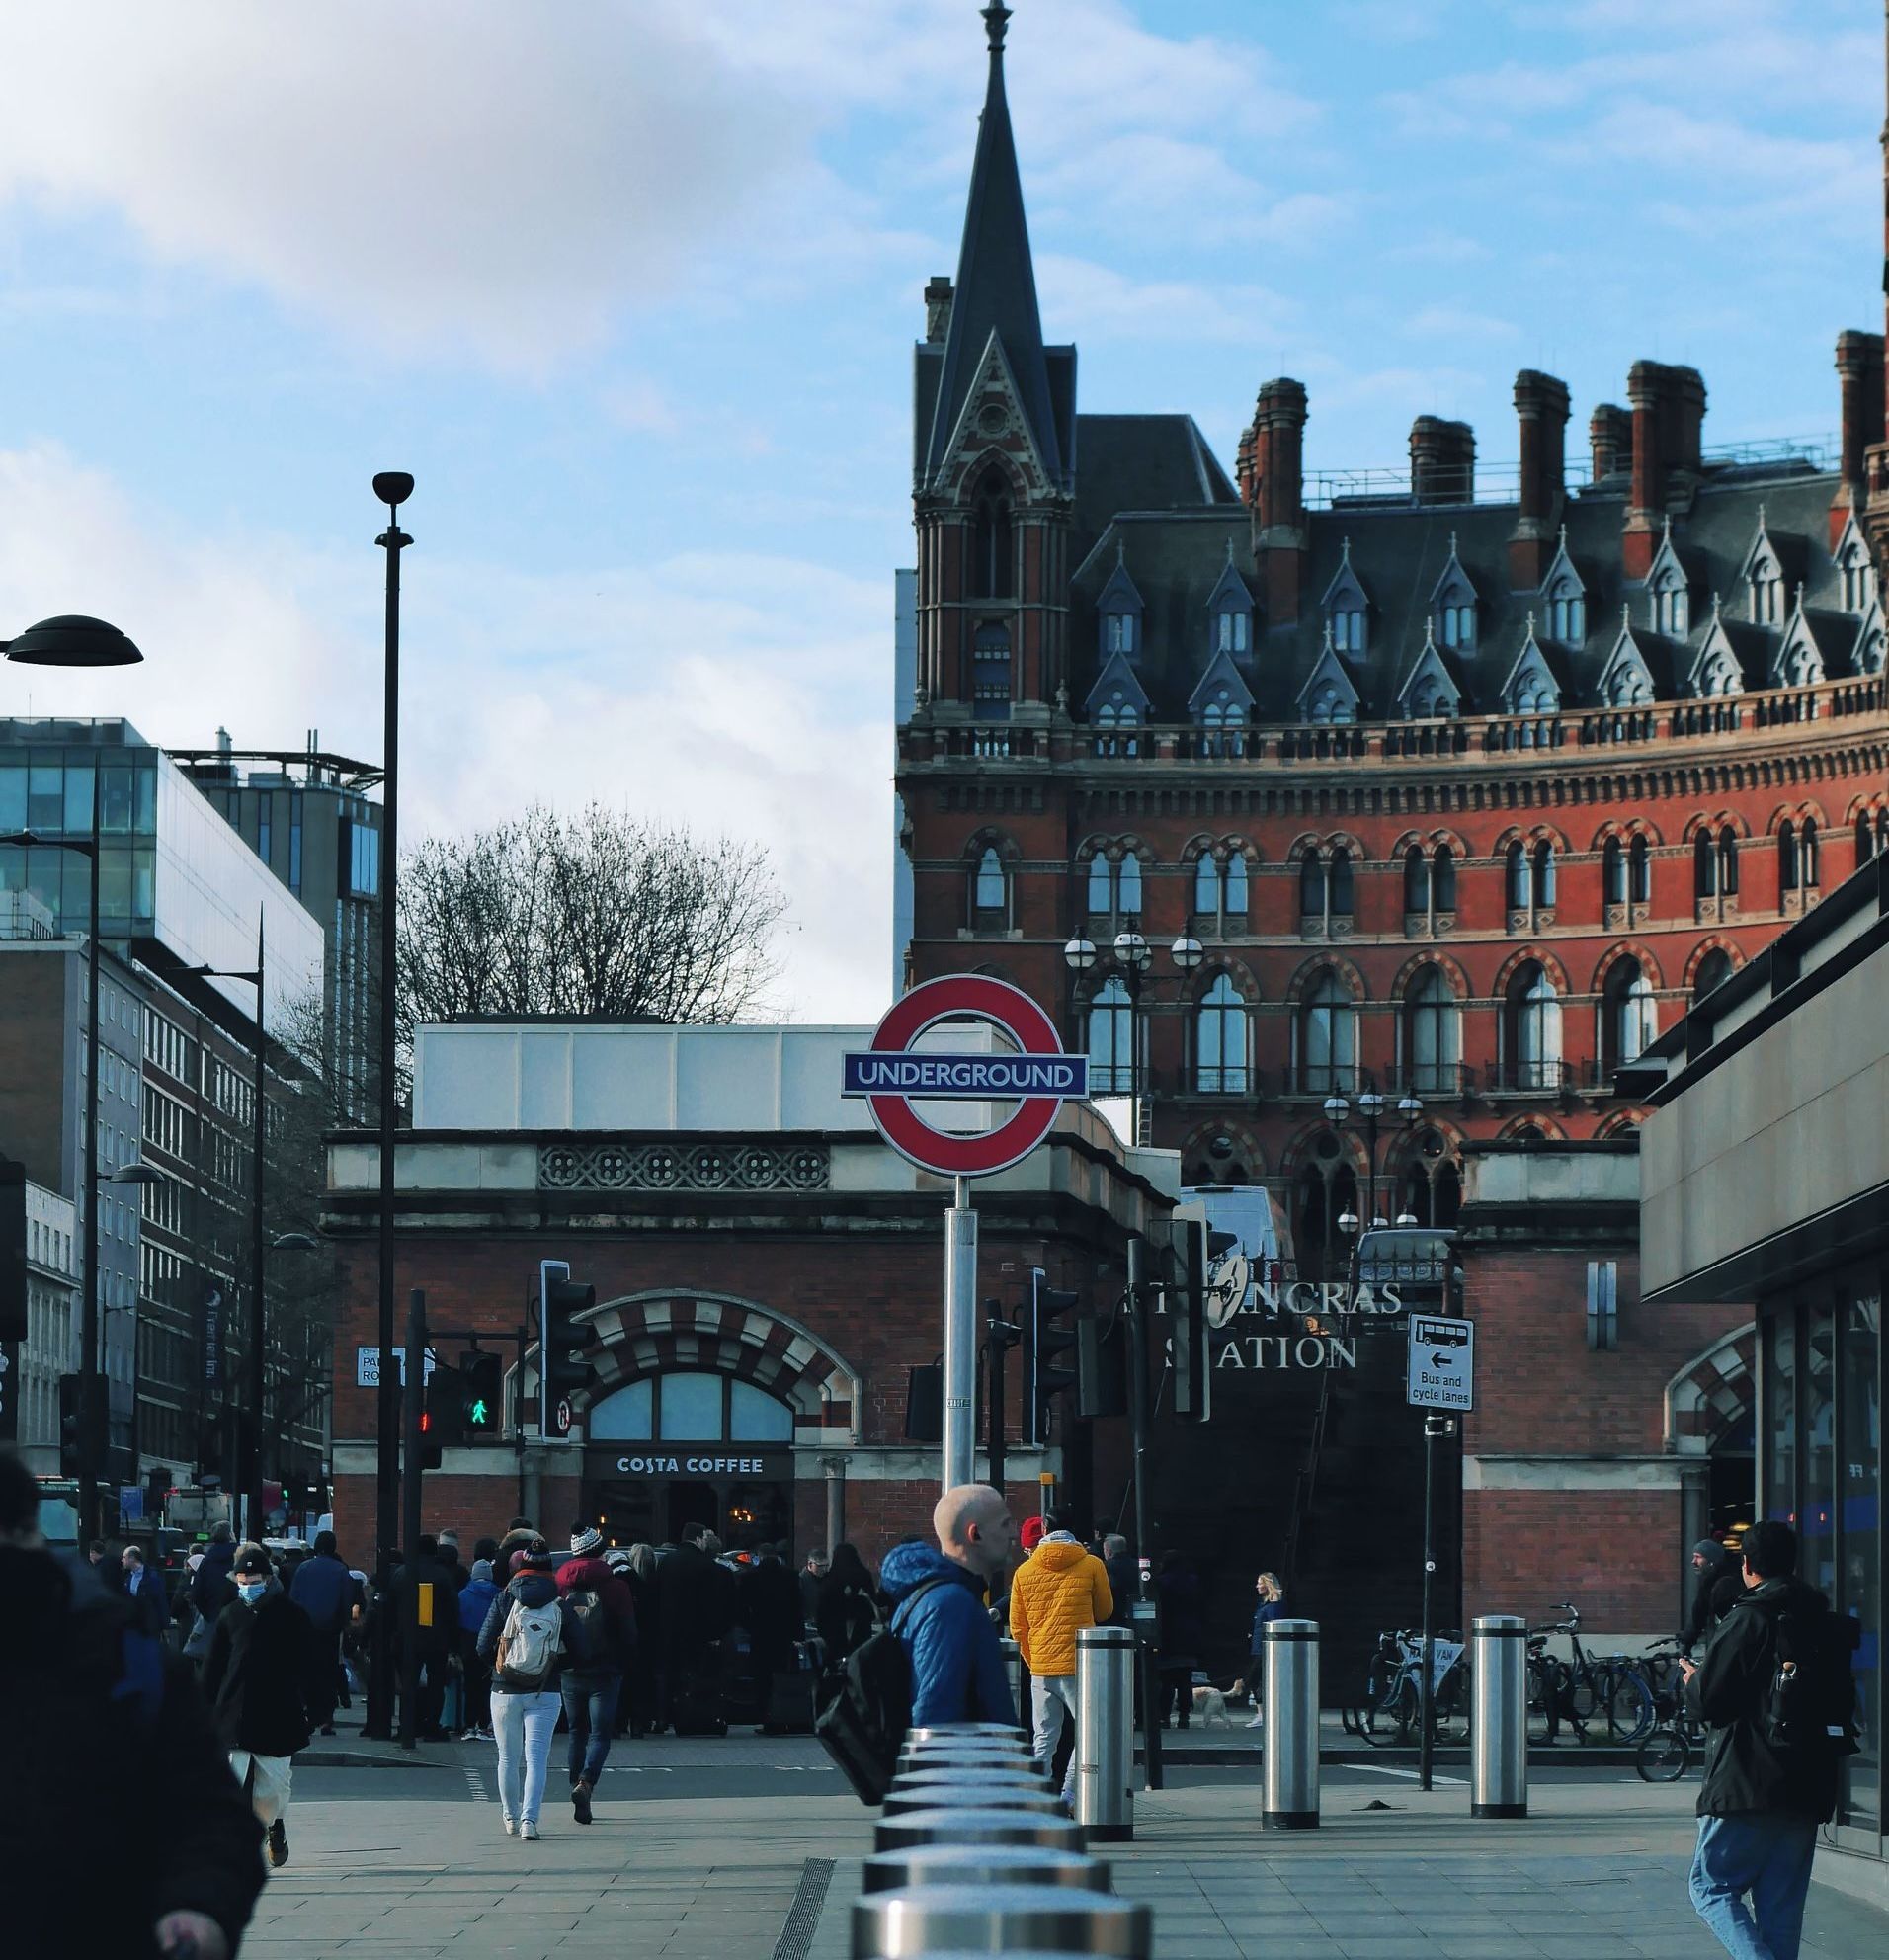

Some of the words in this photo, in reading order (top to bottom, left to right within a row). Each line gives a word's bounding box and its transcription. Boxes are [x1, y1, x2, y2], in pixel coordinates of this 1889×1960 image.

[857, 1061, 1074, 1088] UNDERGROUND
[1239, 1282, 1401, 1315] NCRAS
[1421, 1371, 1440, 1385] Bus
[1442, 1375, 1462, 1387] and
[1412, 1389, 1439, 1401] cycle
[1441, 1389, 1470, 1404] lanes
[616, 1457, 679, 1474] COSTA
[686, 1457, 764, 1473] COFFEE
[1436, 1649, 1453, 1660] VAN
